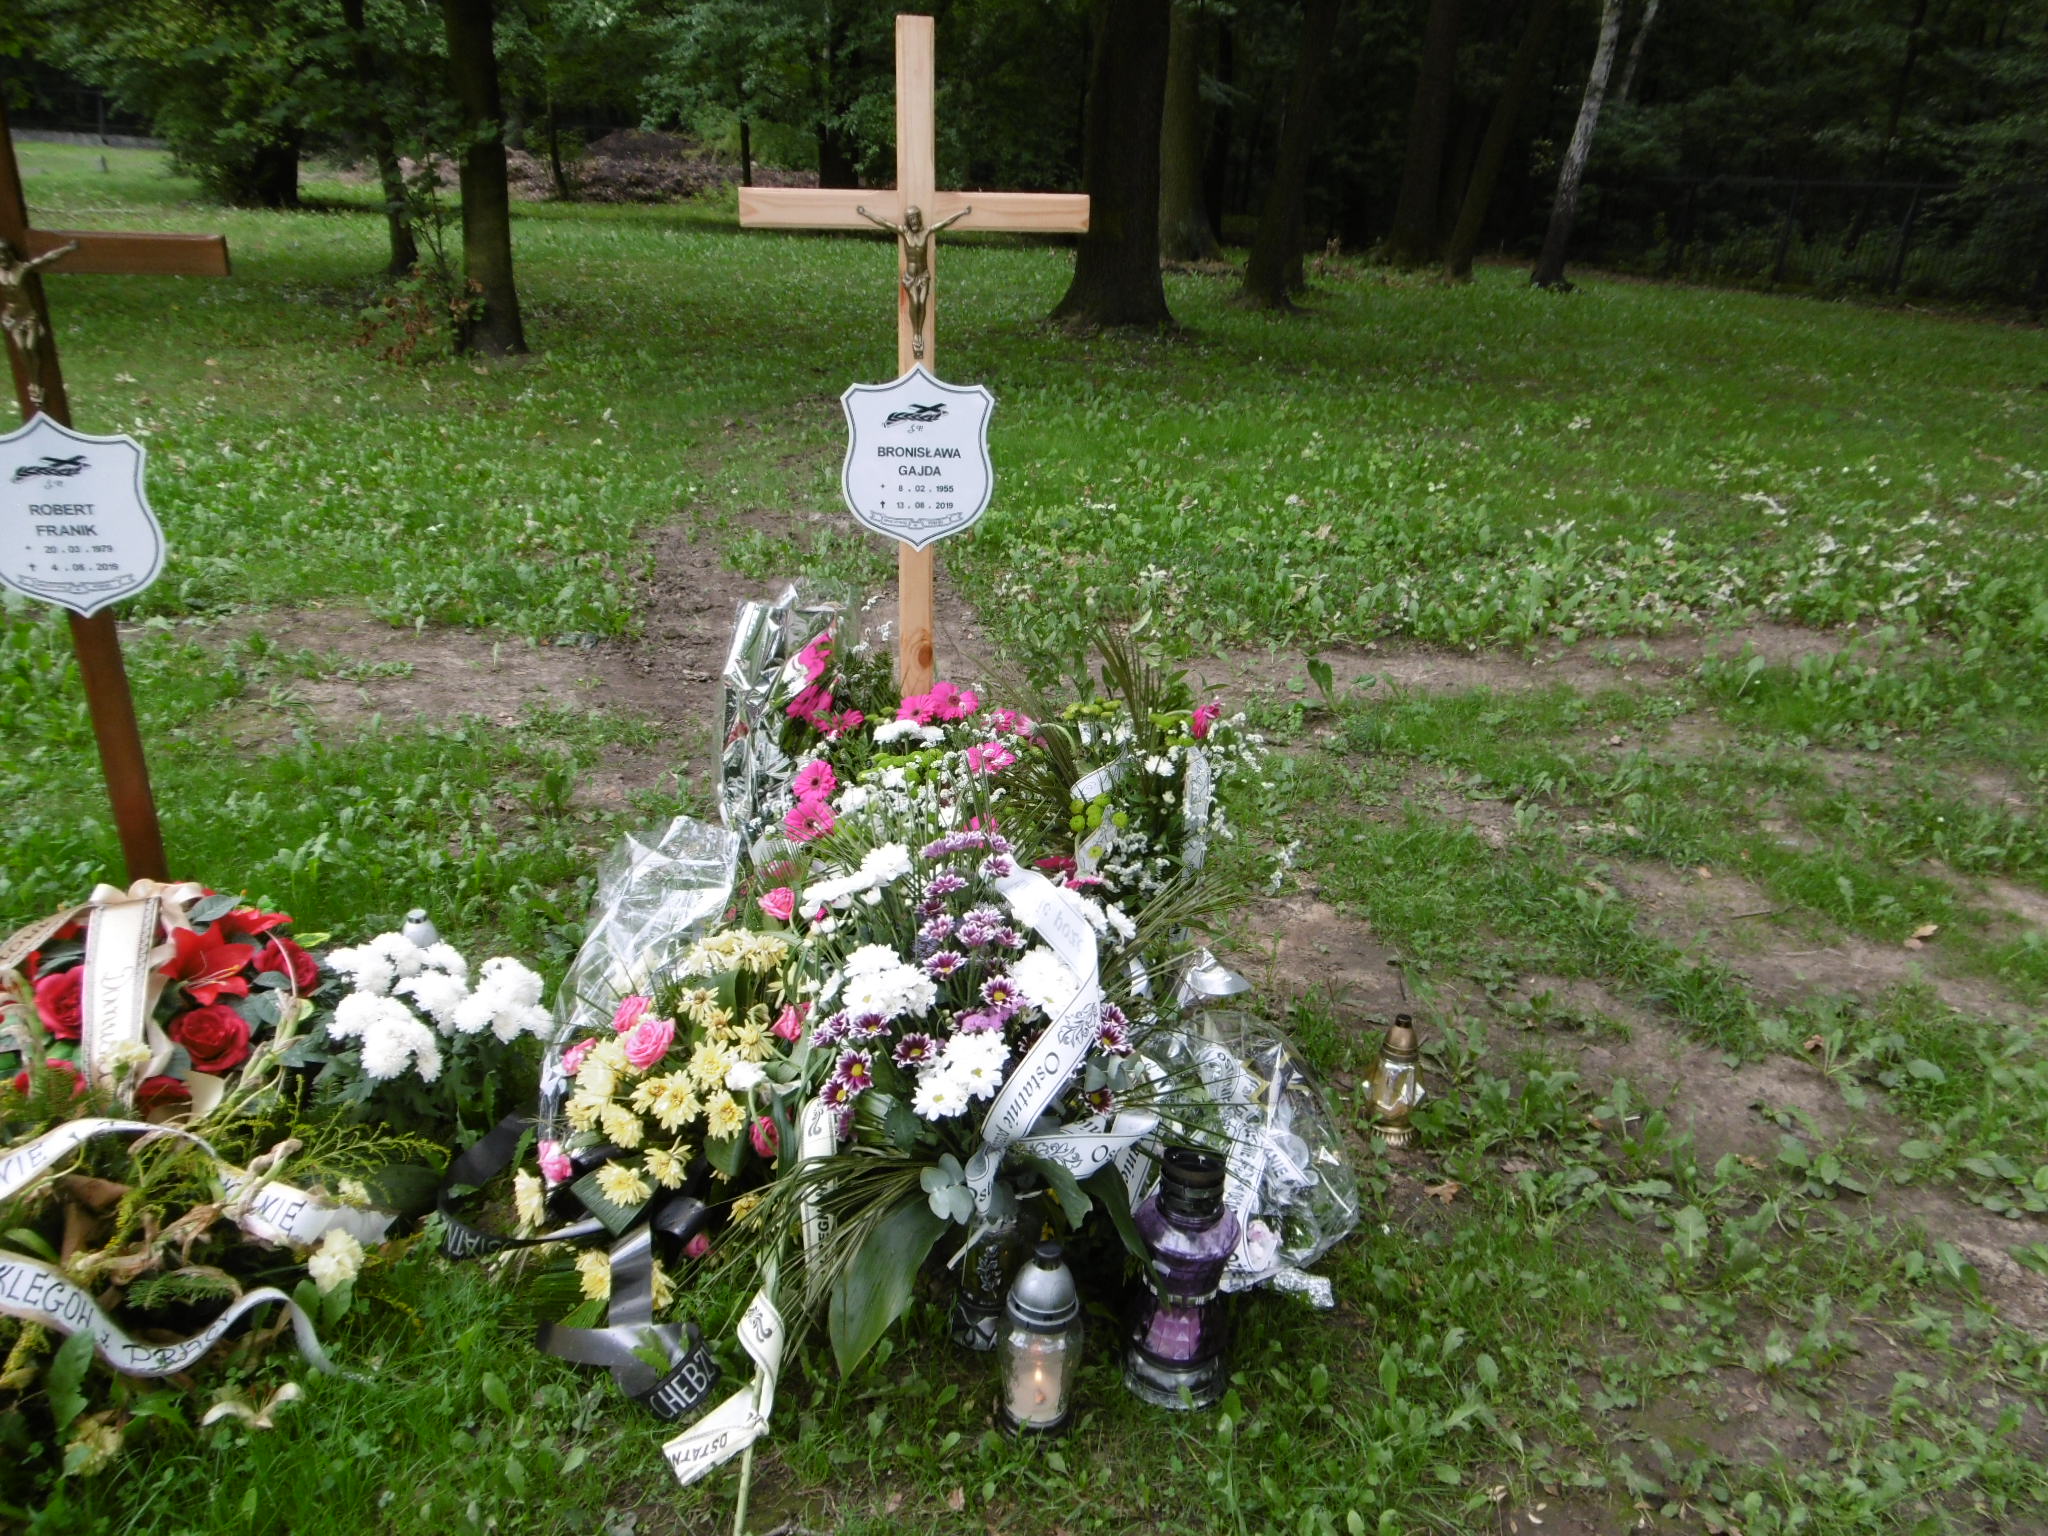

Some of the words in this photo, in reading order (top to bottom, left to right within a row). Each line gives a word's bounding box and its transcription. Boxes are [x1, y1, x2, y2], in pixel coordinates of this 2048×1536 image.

[877, 446, 961, 459] BRONISŁAWA
[898, 465, 942, 477] GAJDA
[29, 504, 95, 516] ROBERT
[35, 525, 98, 536] FRANIK
